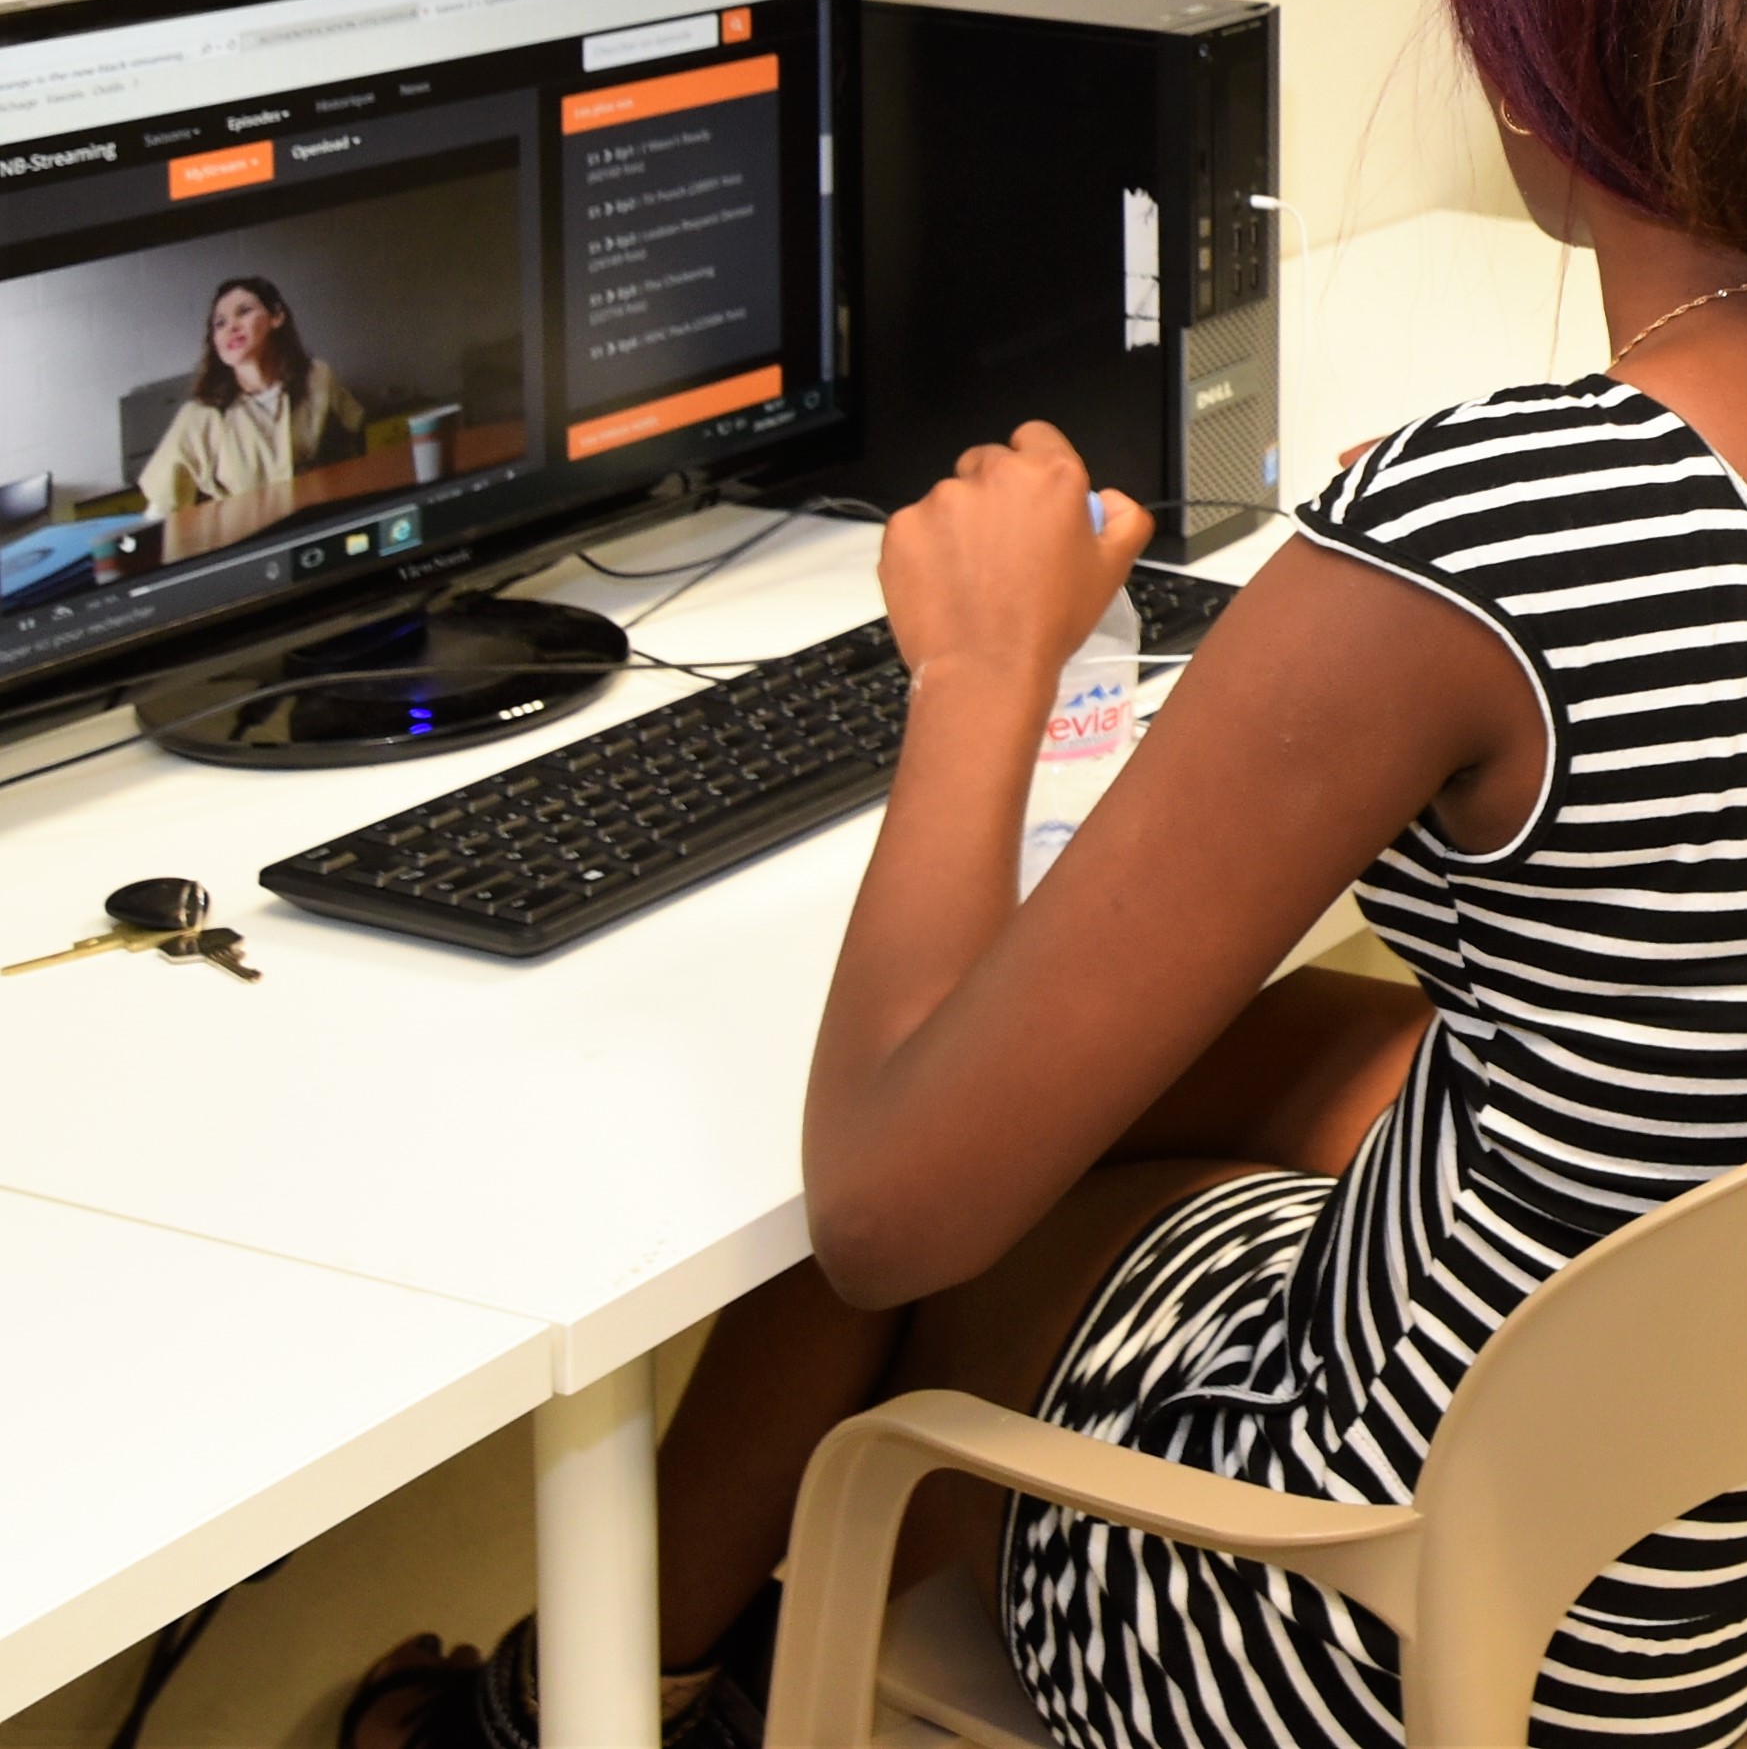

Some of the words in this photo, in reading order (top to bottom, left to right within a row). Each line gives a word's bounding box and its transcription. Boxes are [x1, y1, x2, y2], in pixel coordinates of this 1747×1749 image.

[226, 110, 281, 132] Episodes
[0, 141, 117, 177] NB-Streaming
[291, 135, 350, 161] Openload
[1196, 380, 1235, 411] DELL
